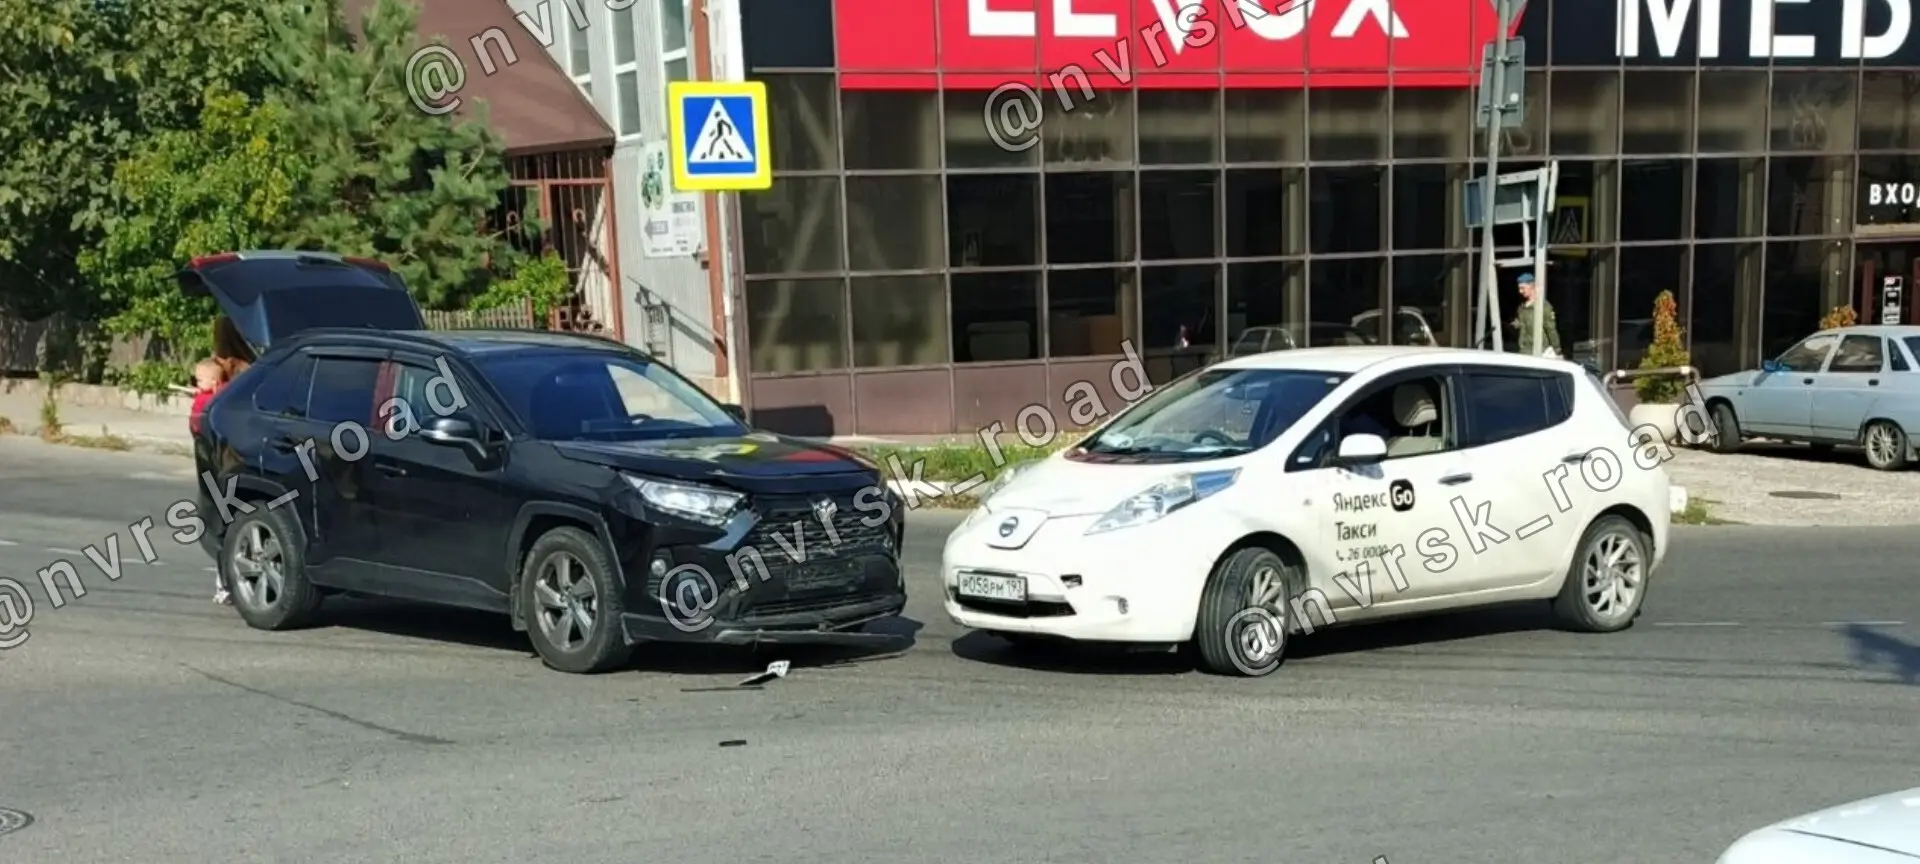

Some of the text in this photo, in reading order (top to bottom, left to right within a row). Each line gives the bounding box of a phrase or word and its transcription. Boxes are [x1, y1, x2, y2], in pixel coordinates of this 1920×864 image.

[1869, 182, 1920, 208] ВХО
[1332, 485, 1414, 512] Яндекс Go
[1334, 520, 1377, 541] Такси
